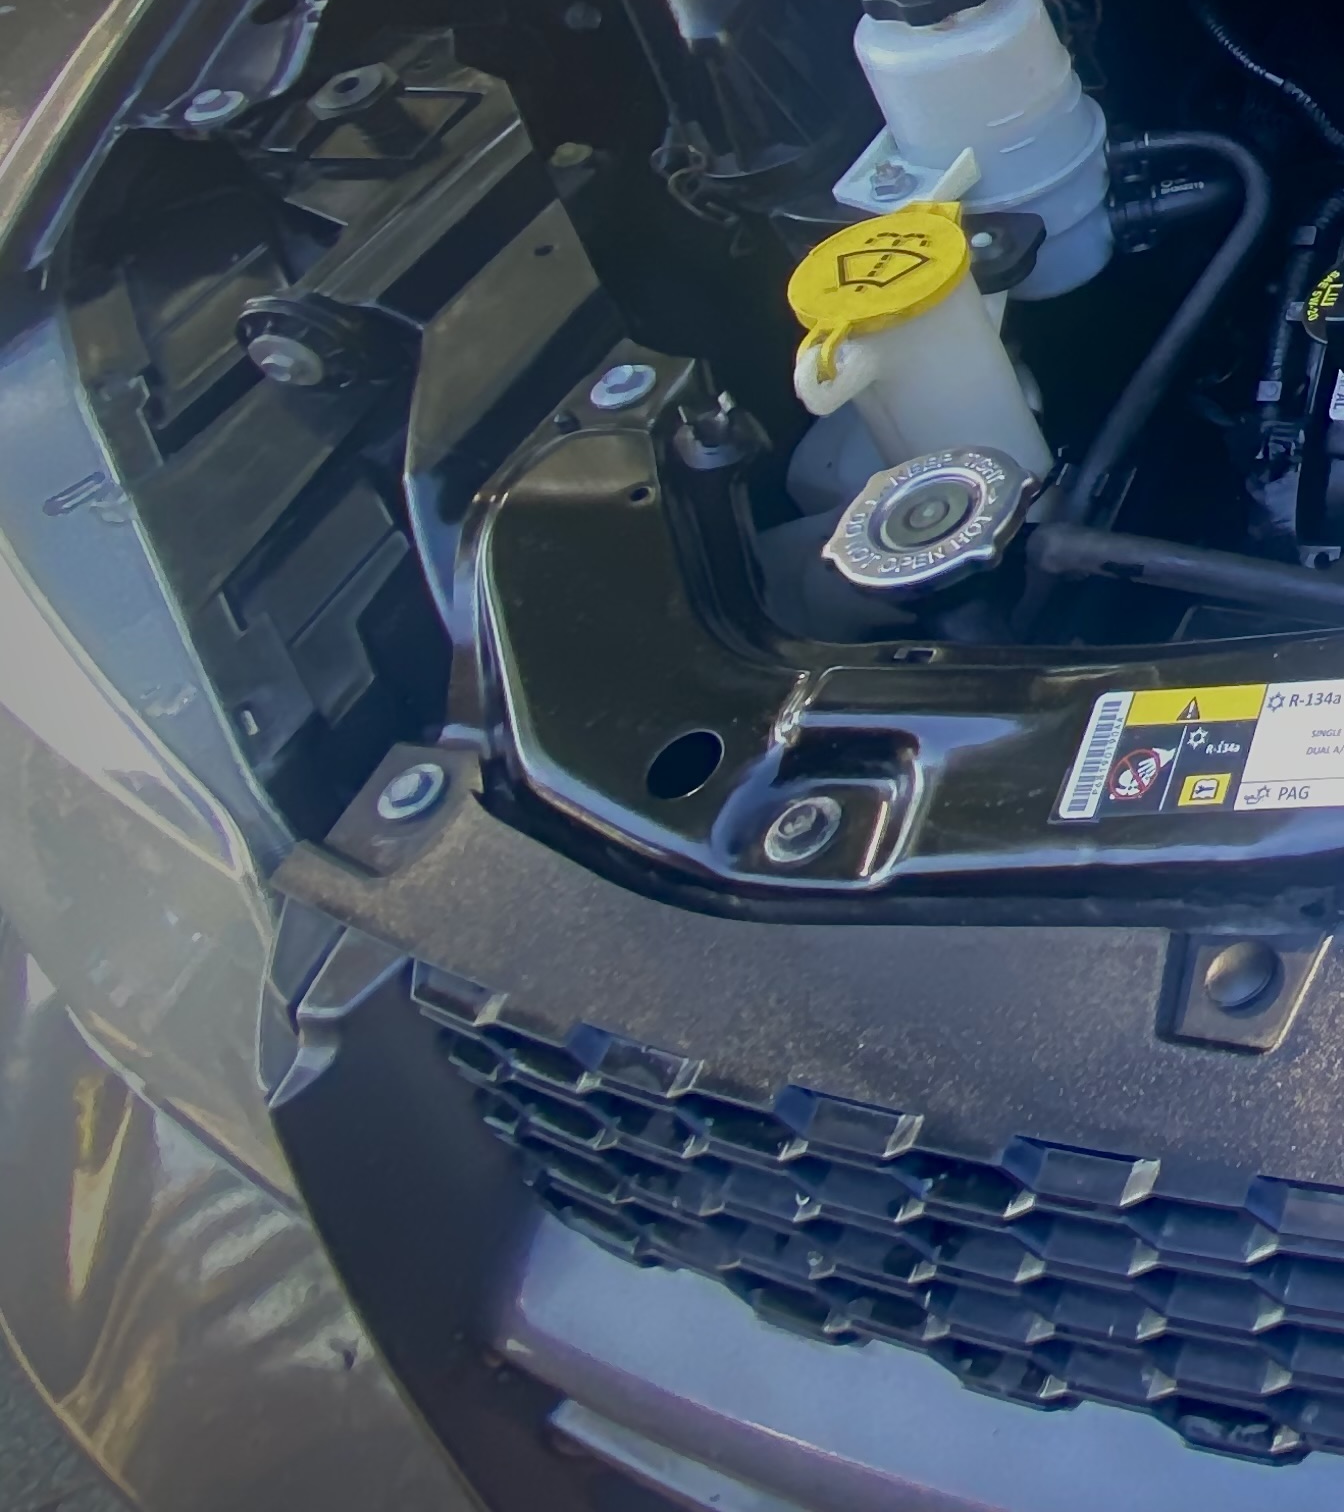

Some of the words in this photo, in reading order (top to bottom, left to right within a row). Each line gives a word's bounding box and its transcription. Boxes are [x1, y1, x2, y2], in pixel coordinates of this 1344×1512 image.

[1317, 270, 1340, 289] SAE
[1307, 290, 1323, 322] 5W-20
[889, 453, 953, 487] KEEP
[878, 546, 946, 573] OPEN
[949, 515, 993, 551] HOT
[1288, 691, 1342, 708] R-134a
[1311, 728, 1342, 738] SINGLE
[1306, 746, 1331, 755] DUAL
[1277, 786, 1311, 801] PAG
